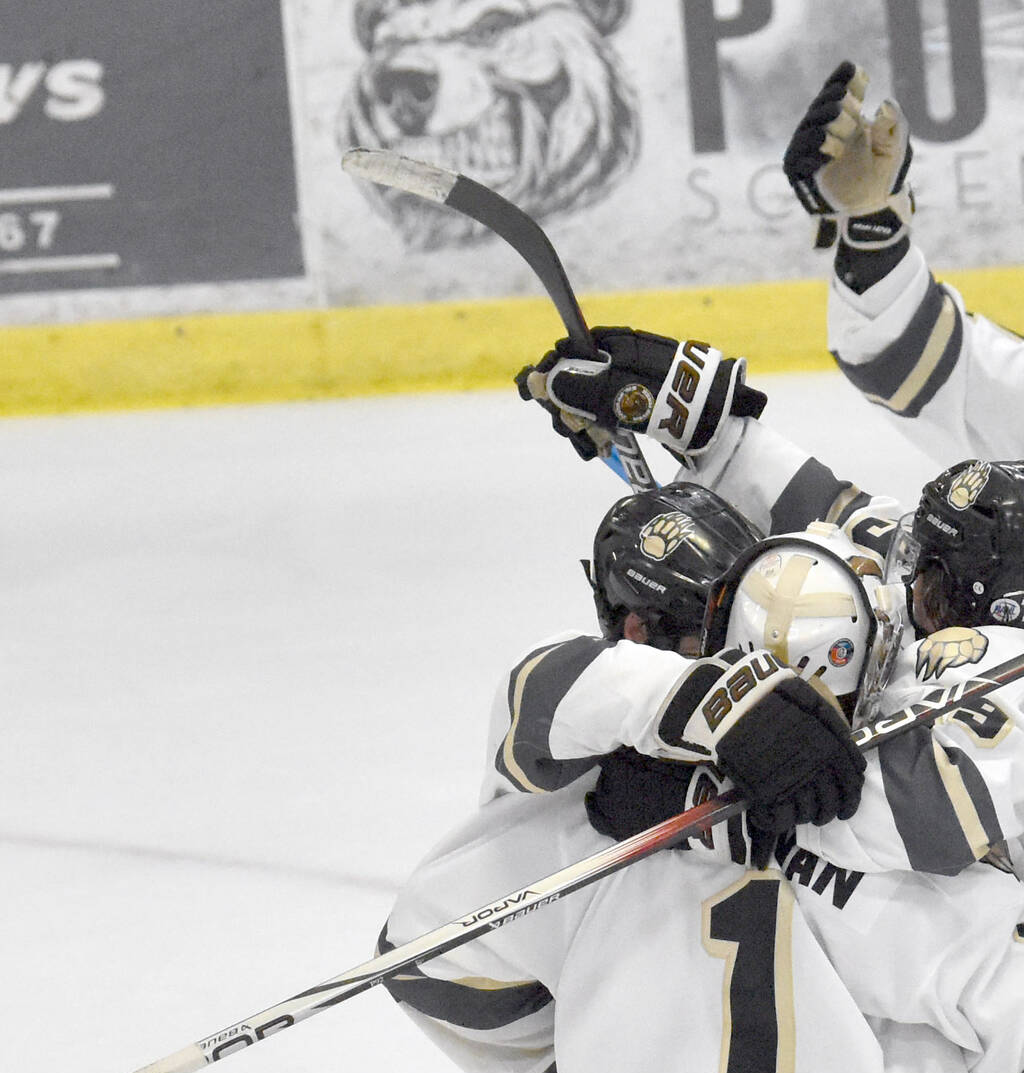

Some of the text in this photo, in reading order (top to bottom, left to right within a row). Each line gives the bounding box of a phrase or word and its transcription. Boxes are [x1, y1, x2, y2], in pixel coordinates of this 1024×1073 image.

[626, 567, 669, 594] BAUER
[701, 652, 790, 733] BAU
[458, 890, 541, 928] VAPOR
